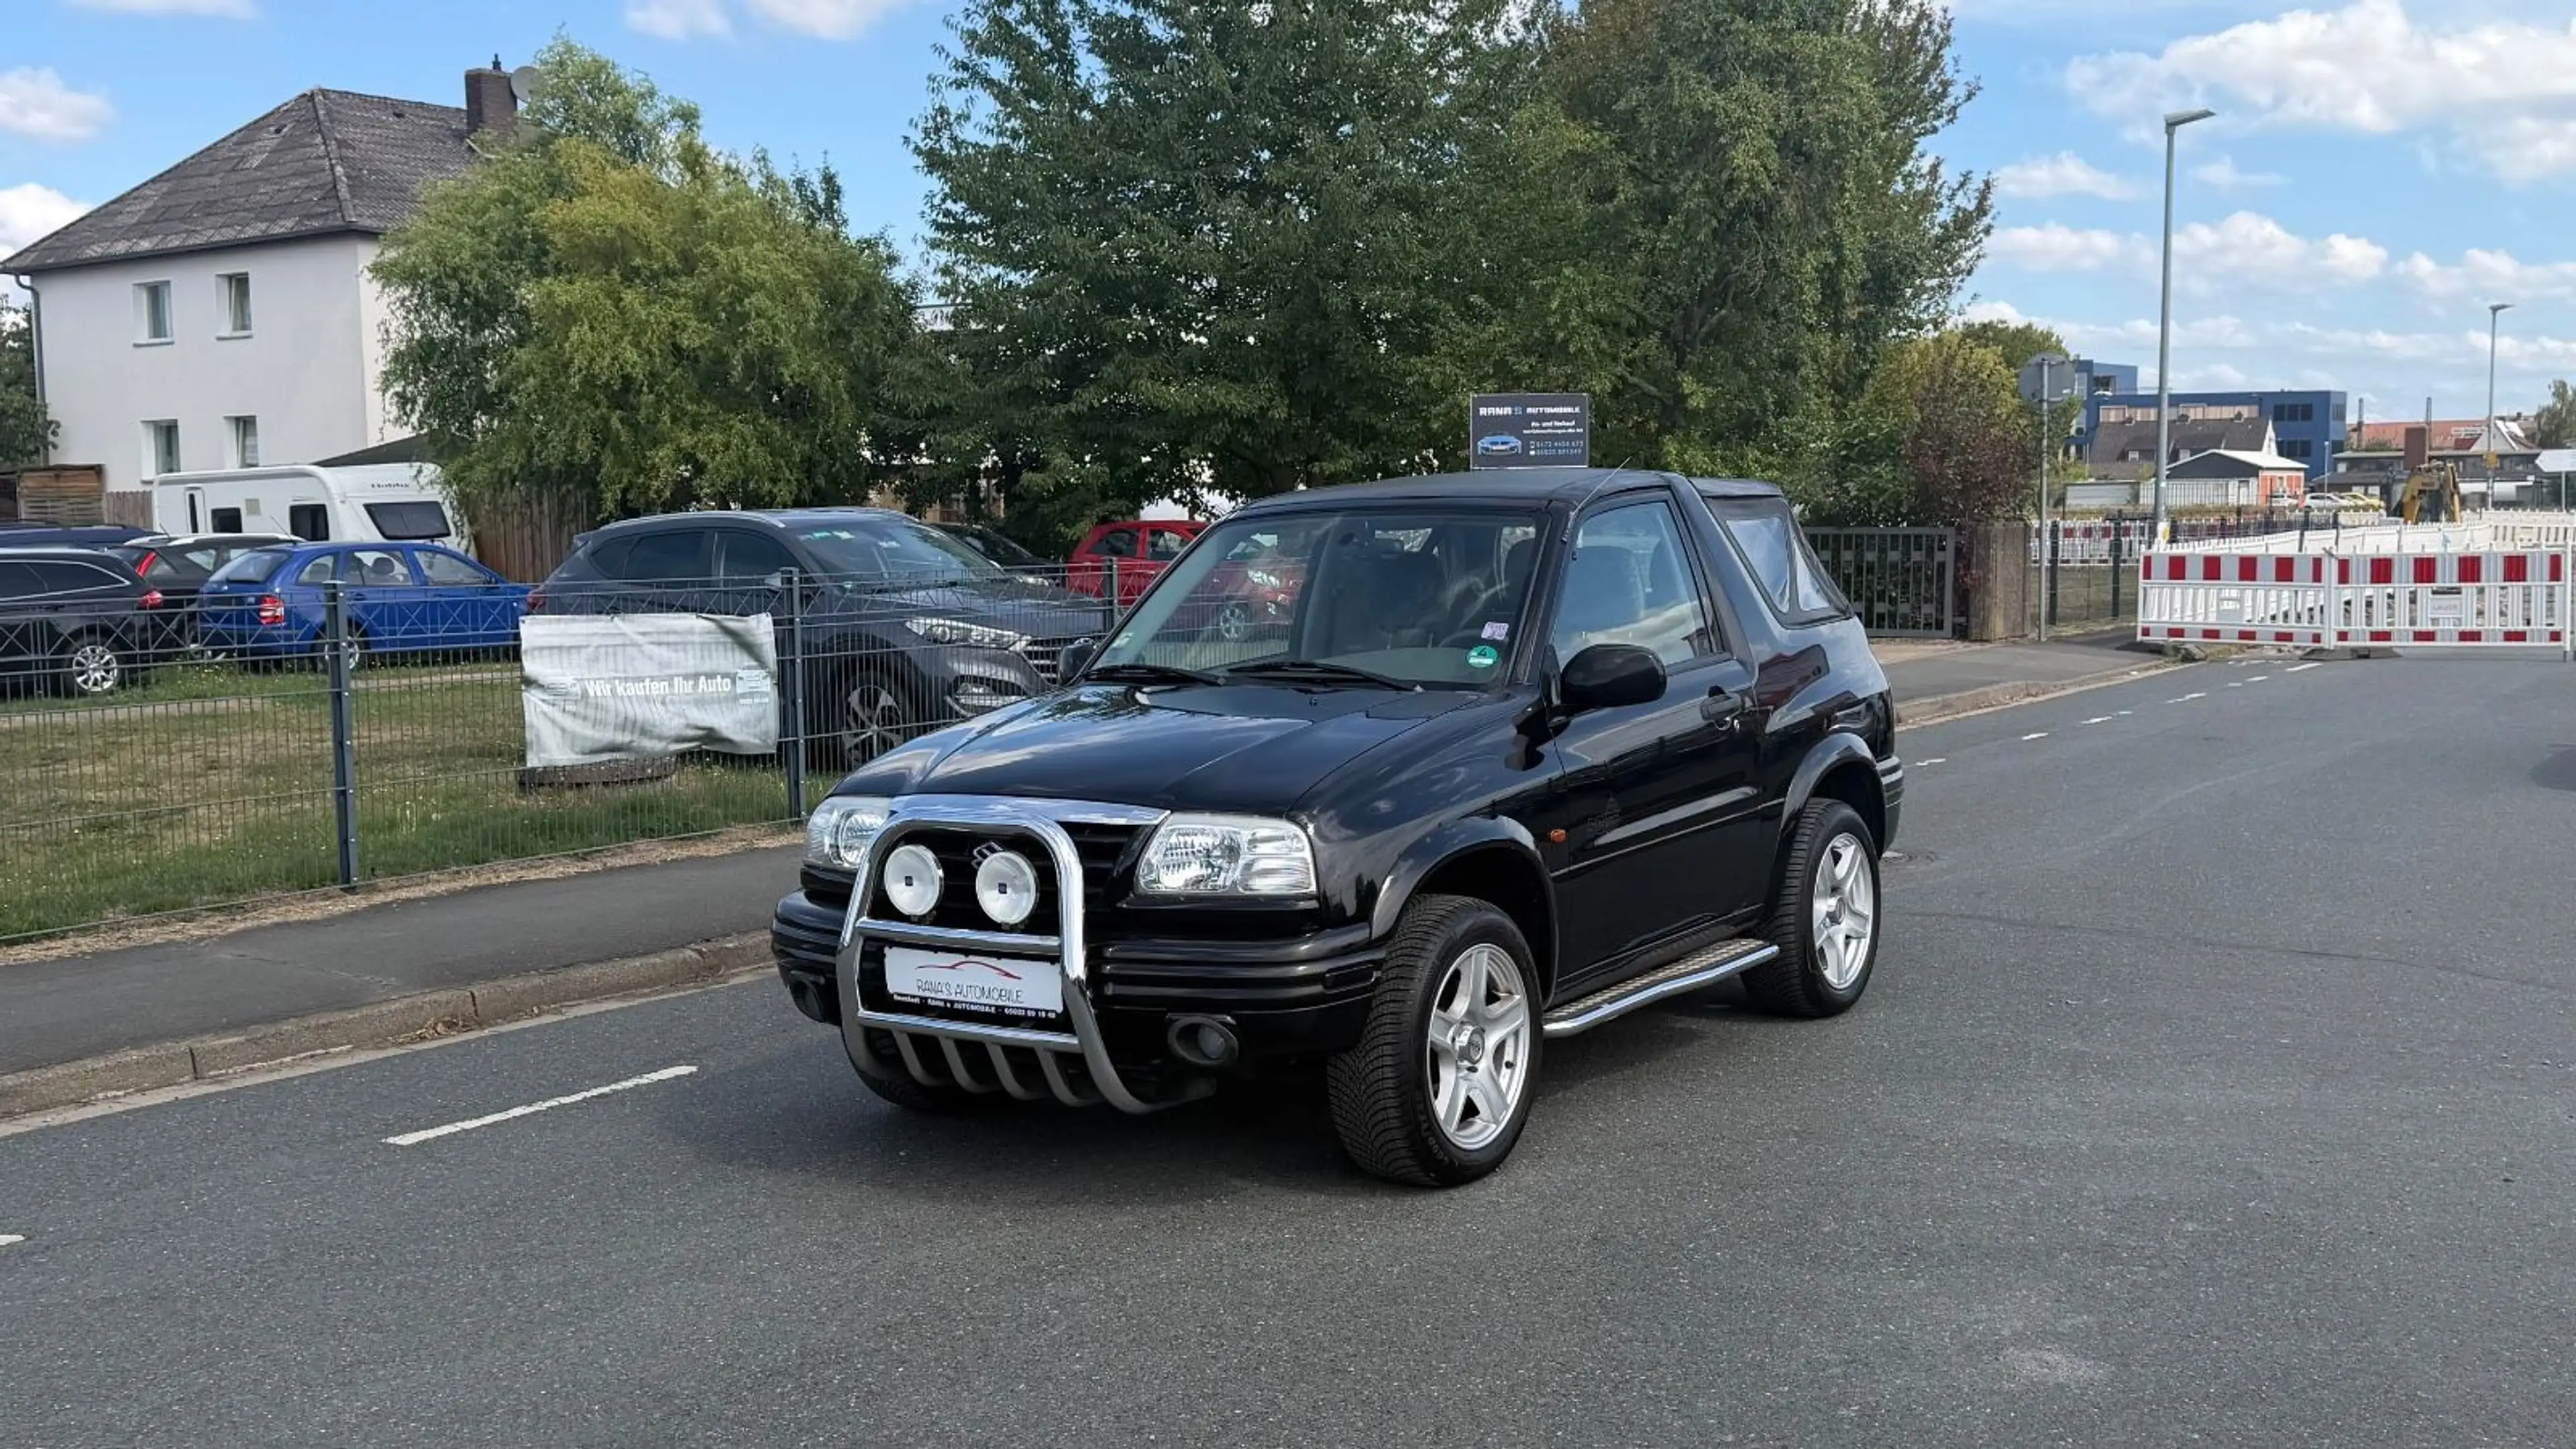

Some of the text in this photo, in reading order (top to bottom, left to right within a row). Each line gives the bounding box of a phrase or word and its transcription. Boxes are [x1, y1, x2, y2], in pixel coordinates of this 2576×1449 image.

[586, 675, 731, 697] Wir kaufen Ihr Auto
[916, 978, 1024, 1004] RANA'S AUTOMOBILE
